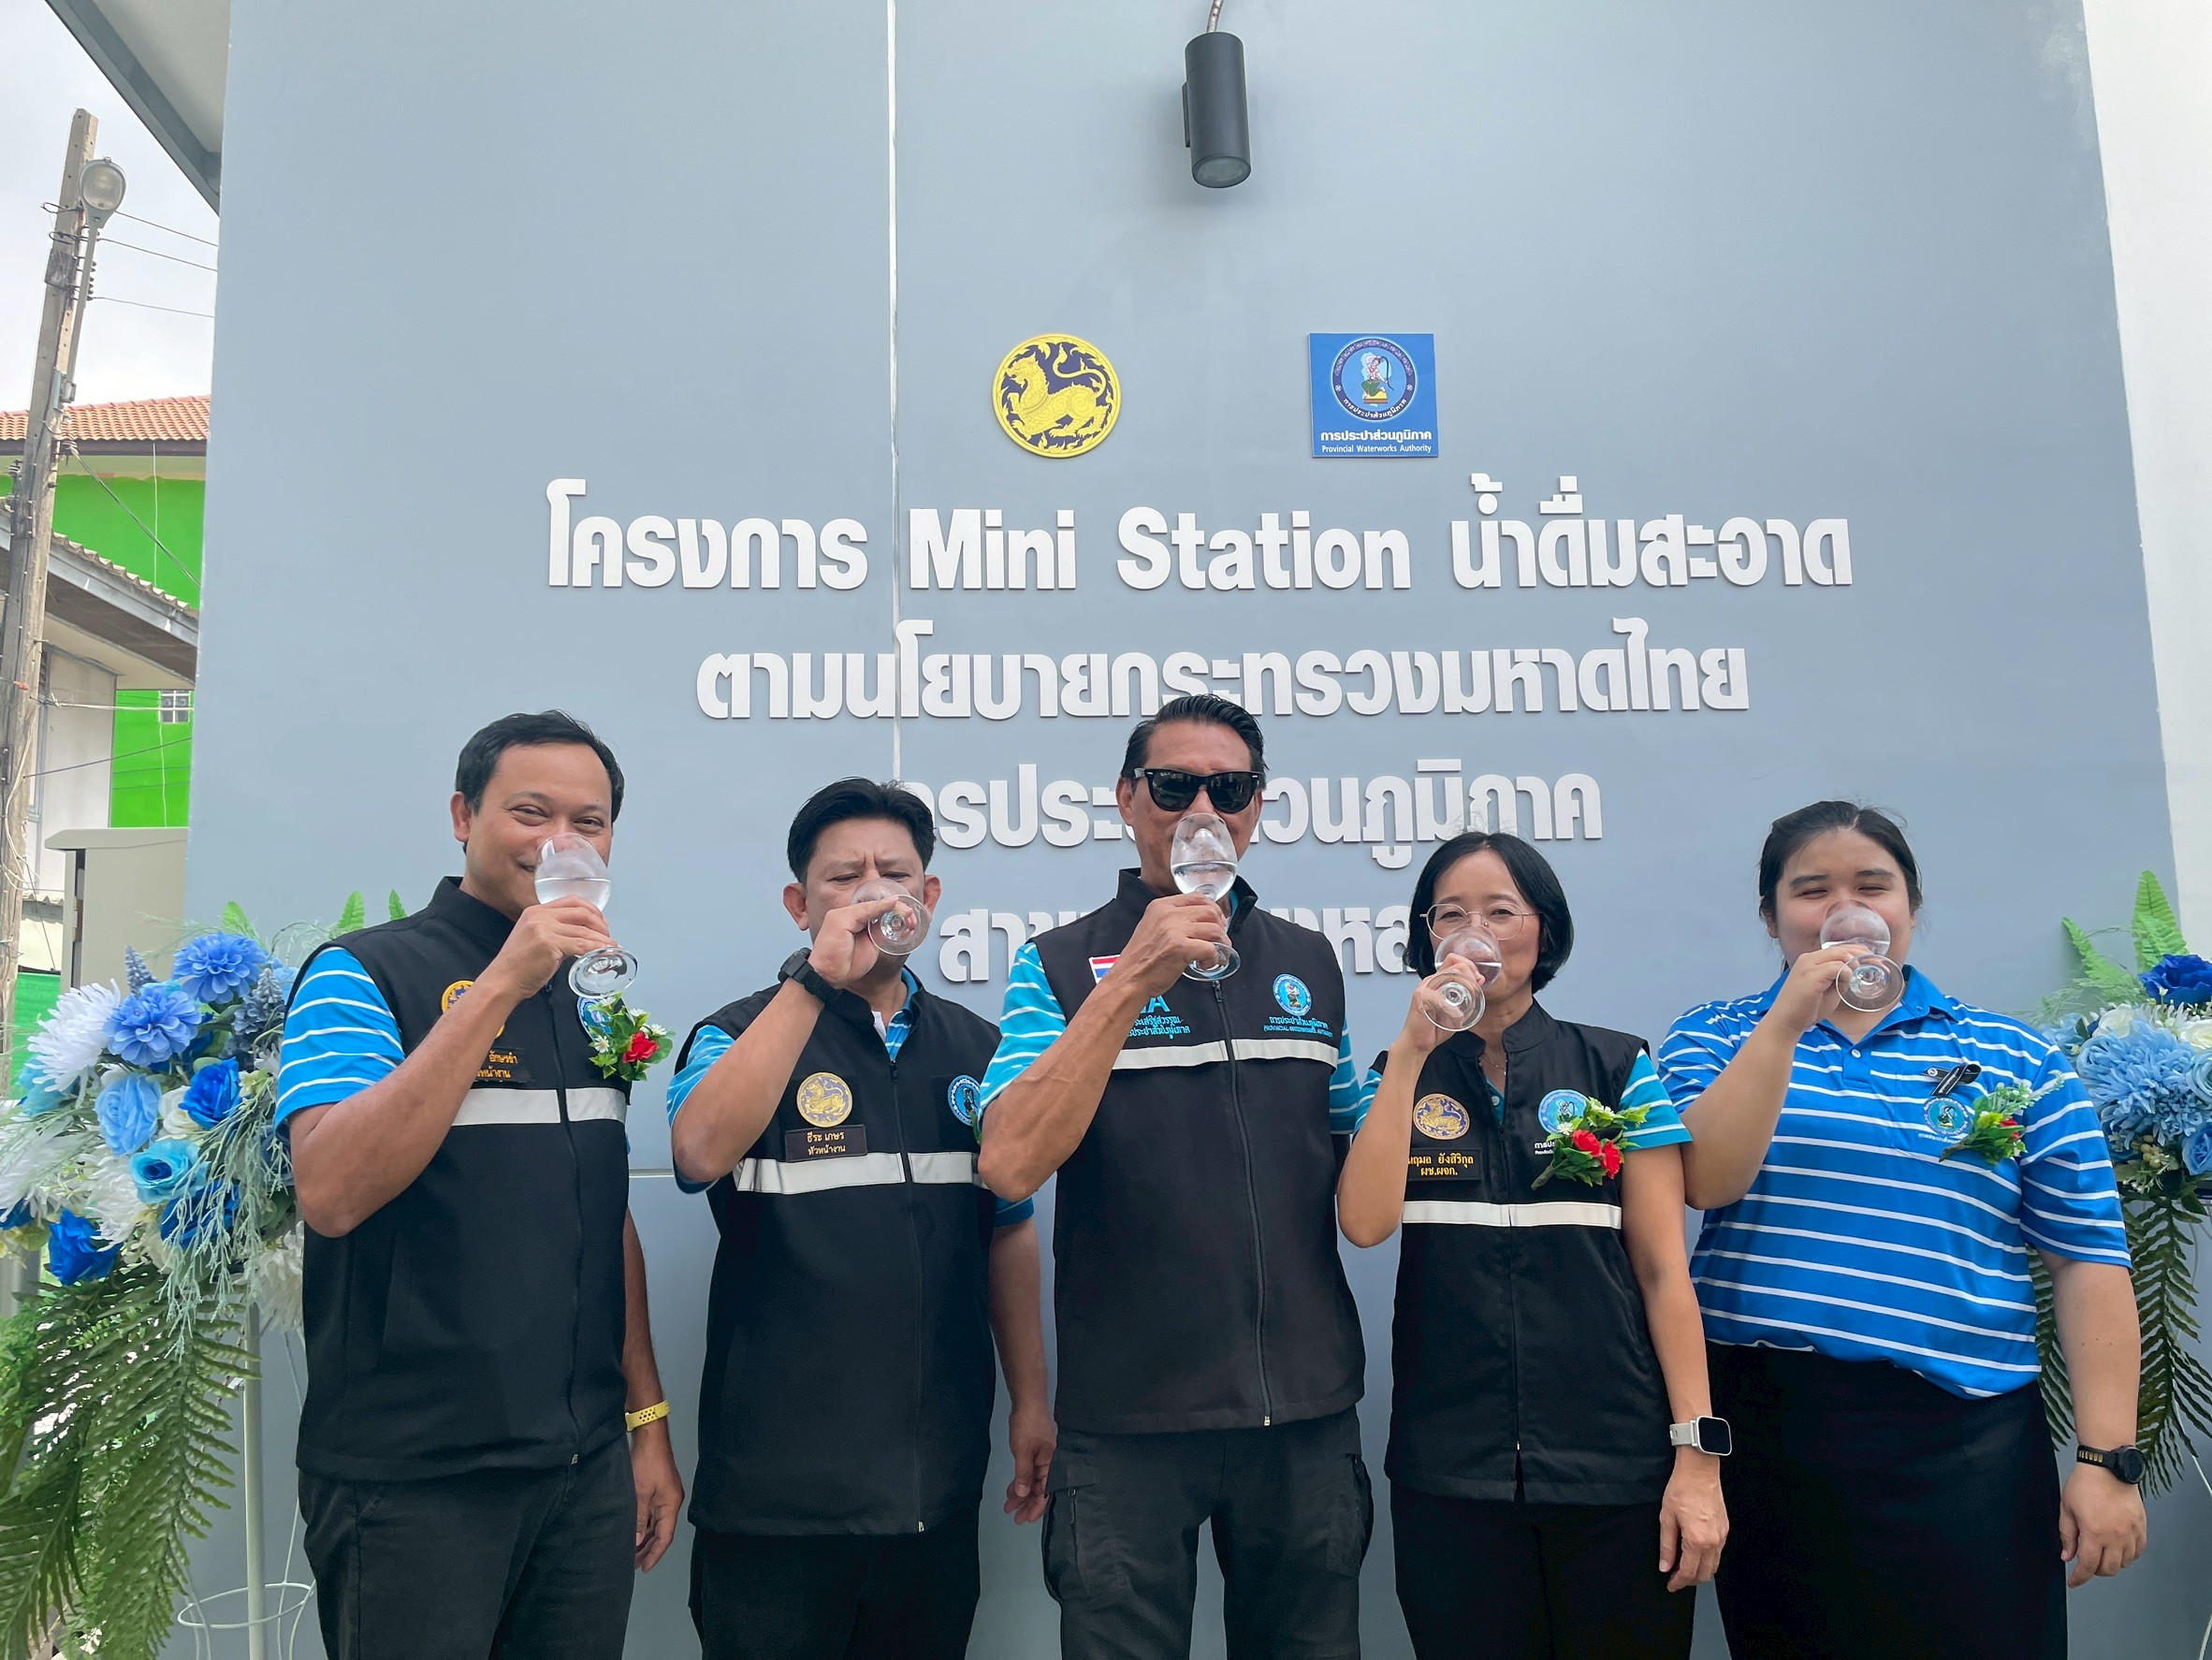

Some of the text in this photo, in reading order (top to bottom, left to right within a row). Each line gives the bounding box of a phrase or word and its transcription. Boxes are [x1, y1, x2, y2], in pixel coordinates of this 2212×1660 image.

[1320, 429, 1433, 443] การประปาส่วนภูมิภาค
[1321, 444, 1354, 453] Provincial
[1400, 444, 1432, 453] Authority
[546, 473, 1854, 591] โครงการ Mini Station น้ำดื่มสะอาด
[696, 618, 1751, 720] ตามนโยบายกระทรวงมหาดไทย
[807, 1130, 822, 1143] ธีระ
[1437, 1152, 1474, 1169] ยังสิริกุล
